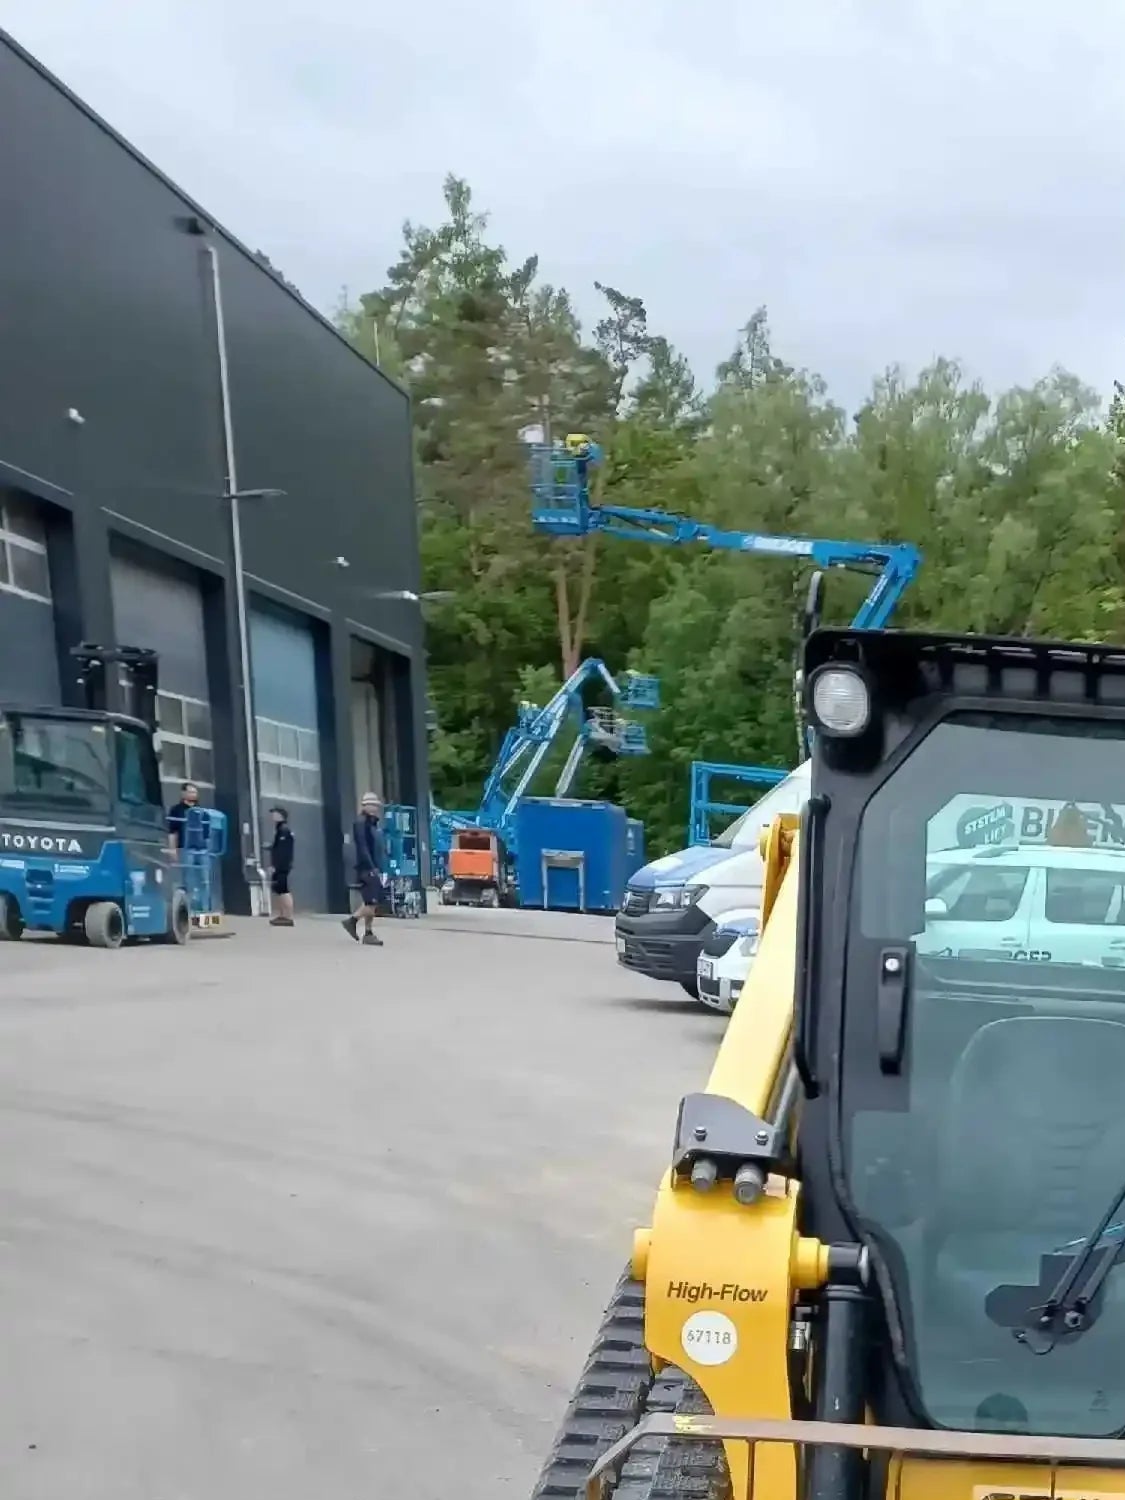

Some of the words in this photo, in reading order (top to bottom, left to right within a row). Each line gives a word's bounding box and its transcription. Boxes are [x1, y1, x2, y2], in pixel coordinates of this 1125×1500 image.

[2, 833, 82, 852] TOYOTA
[667, 1281, 768, 1303] High-Flow
[687, 1329, 731, 1345] 67118
